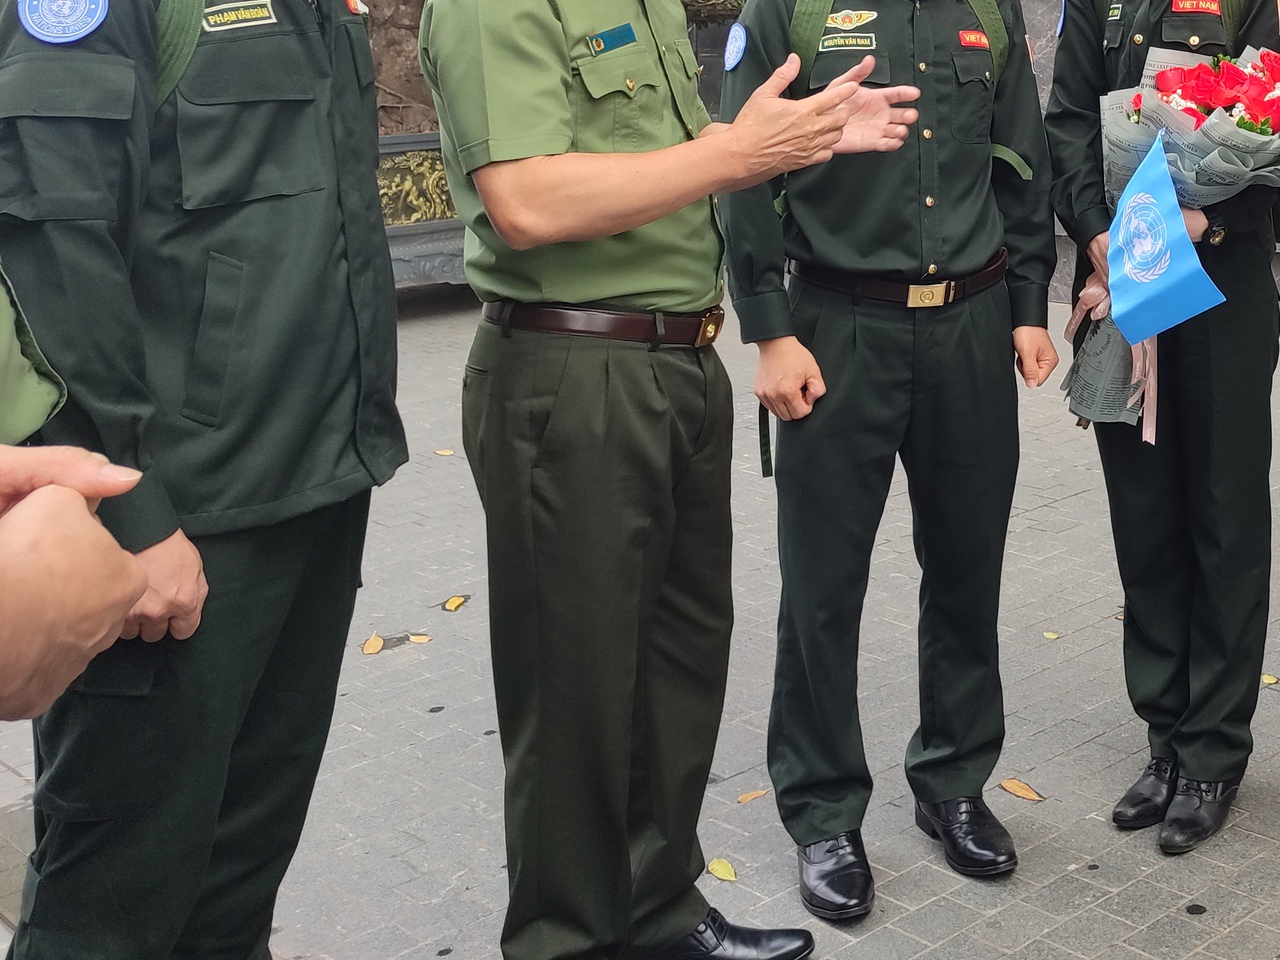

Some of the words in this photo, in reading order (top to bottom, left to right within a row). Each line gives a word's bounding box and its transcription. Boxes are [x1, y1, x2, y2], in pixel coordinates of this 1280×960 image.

[1178, 0, 1198, 9] VIET
[1199, 0, 1218, 11] NAM
[30, 12, 64, 34] NATIONS
[65, 15, 92, 33] UNIES
[208, 10, 238, 25] PHẠM
[963, 34, 980, 43] VIET
